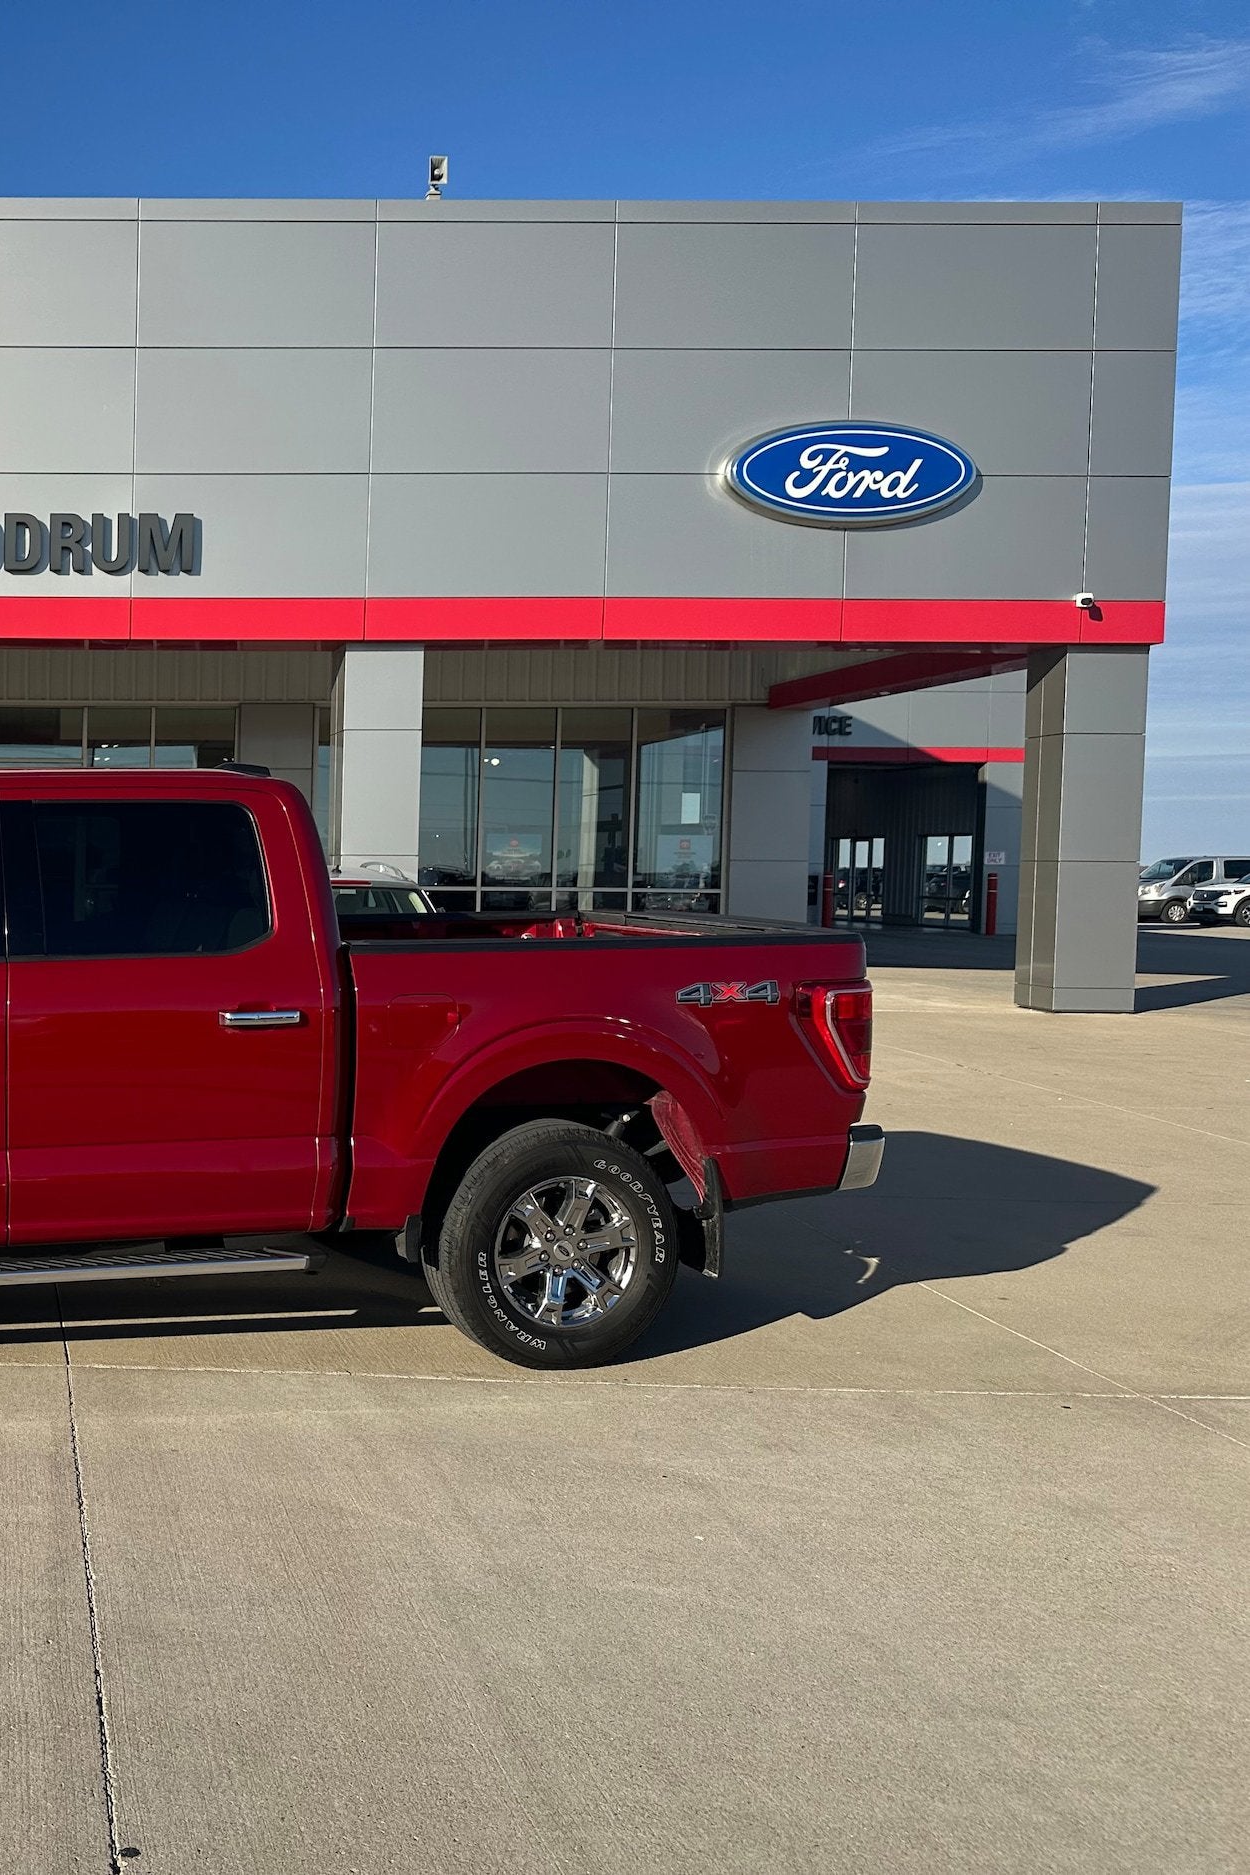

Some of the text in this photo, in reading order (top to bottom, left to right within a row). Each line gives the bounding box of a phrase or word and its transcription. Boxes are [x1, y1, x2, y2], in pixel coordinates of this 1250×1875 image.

[785, 443, 923, 499] Ford
[593, 1158, 666, 1264] GOODYEAR
[476, 1250, 548, 1352] WRANGLER
